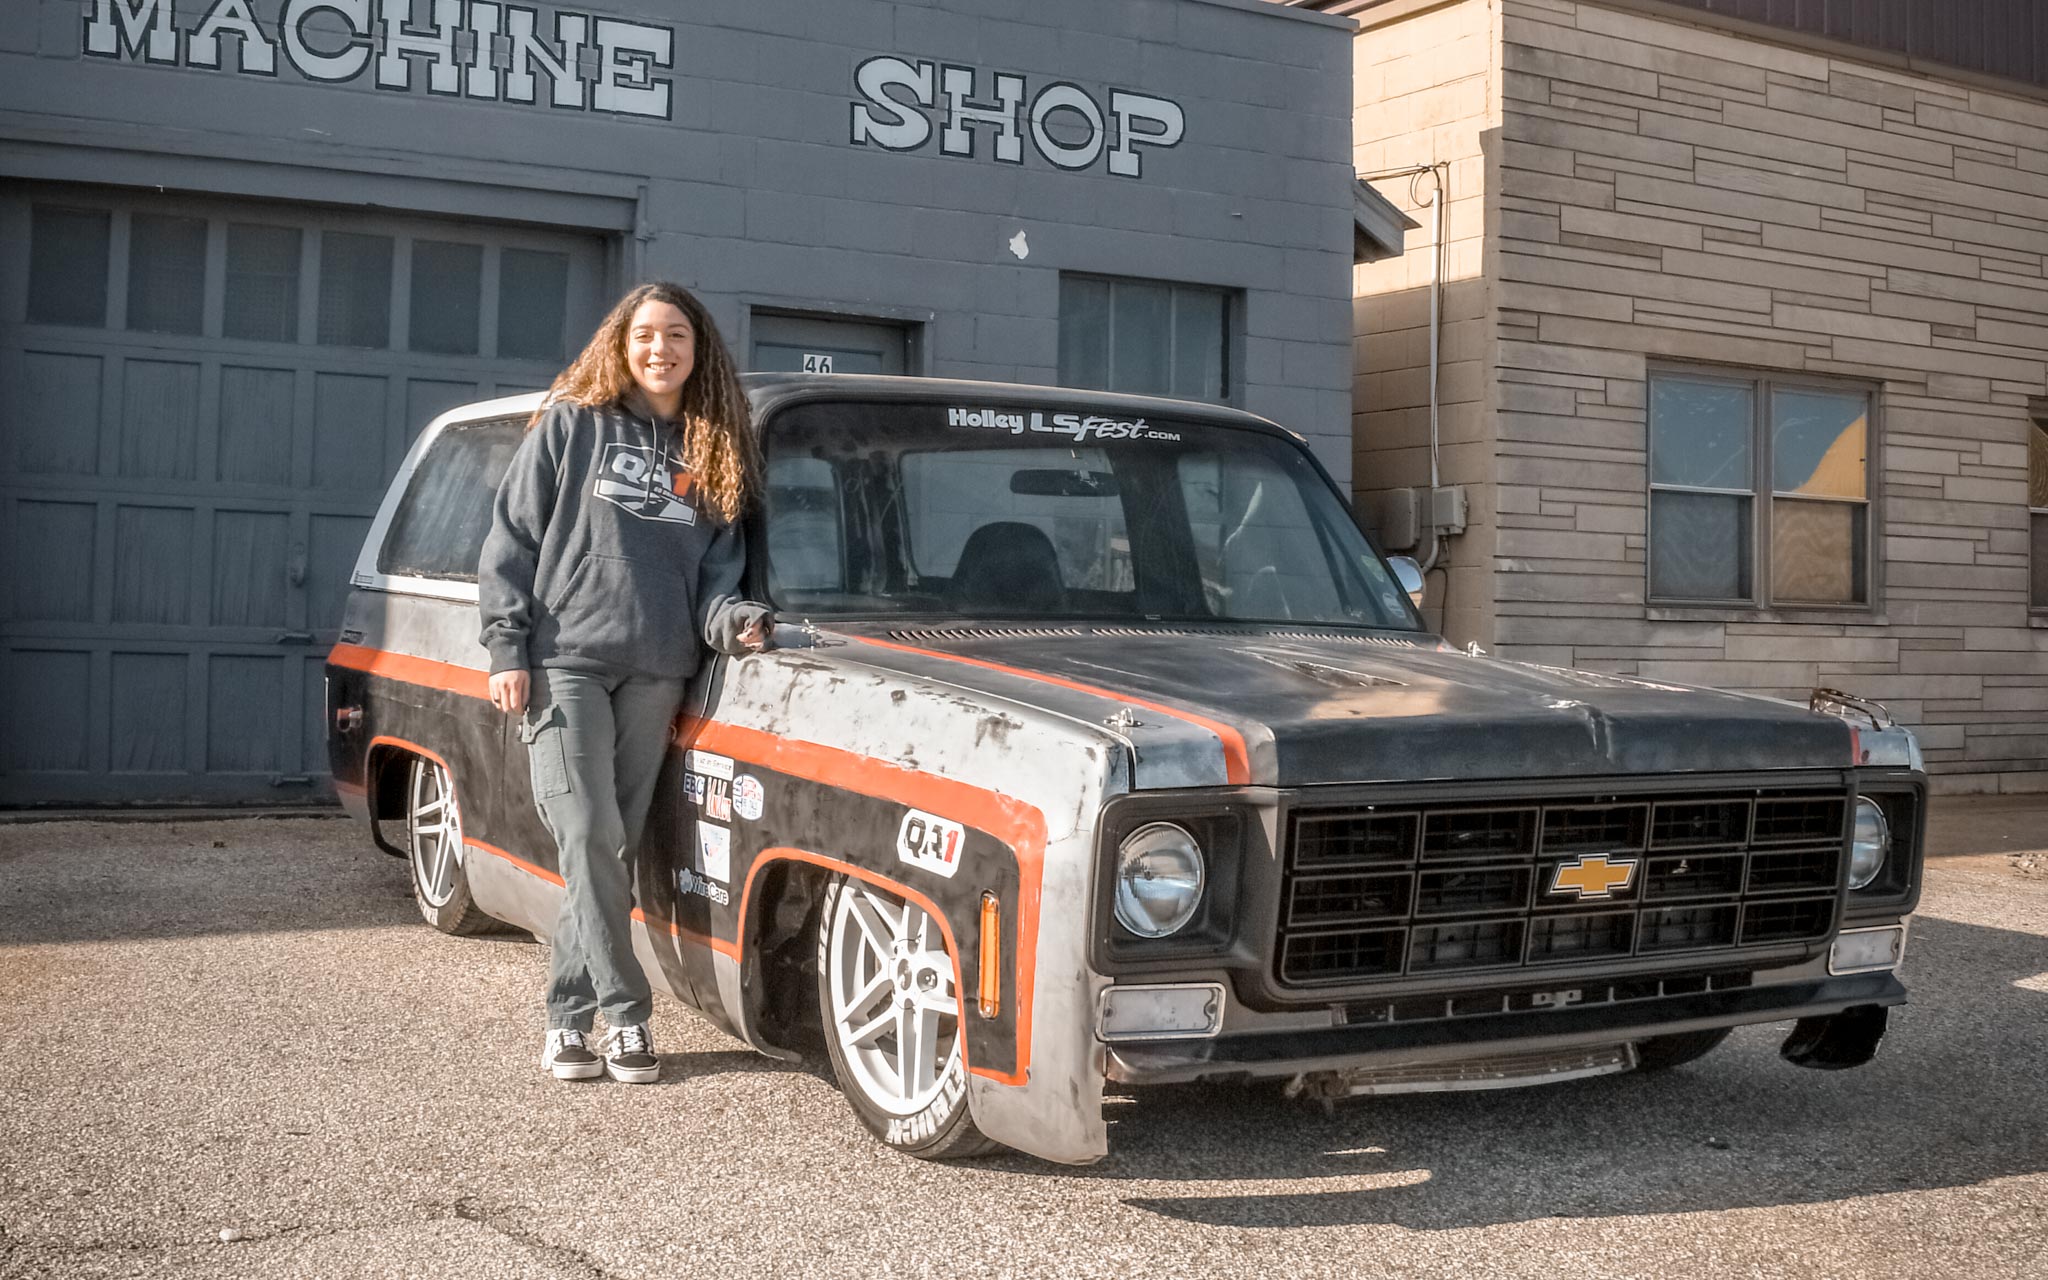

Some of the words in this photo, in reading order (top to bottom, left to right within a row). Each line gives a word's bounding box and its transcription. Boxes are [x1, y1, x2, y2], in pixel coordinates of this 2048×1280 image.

[83, 0, 674, 120] MACHINE
[850, 55, 1186, 179] SHOP
[804, 355, 831, 374] 46
[948, 408, 1024, 434] Holley
[685, 775, 705, 796] EBC
[903, 816, 959, 864] QA1
